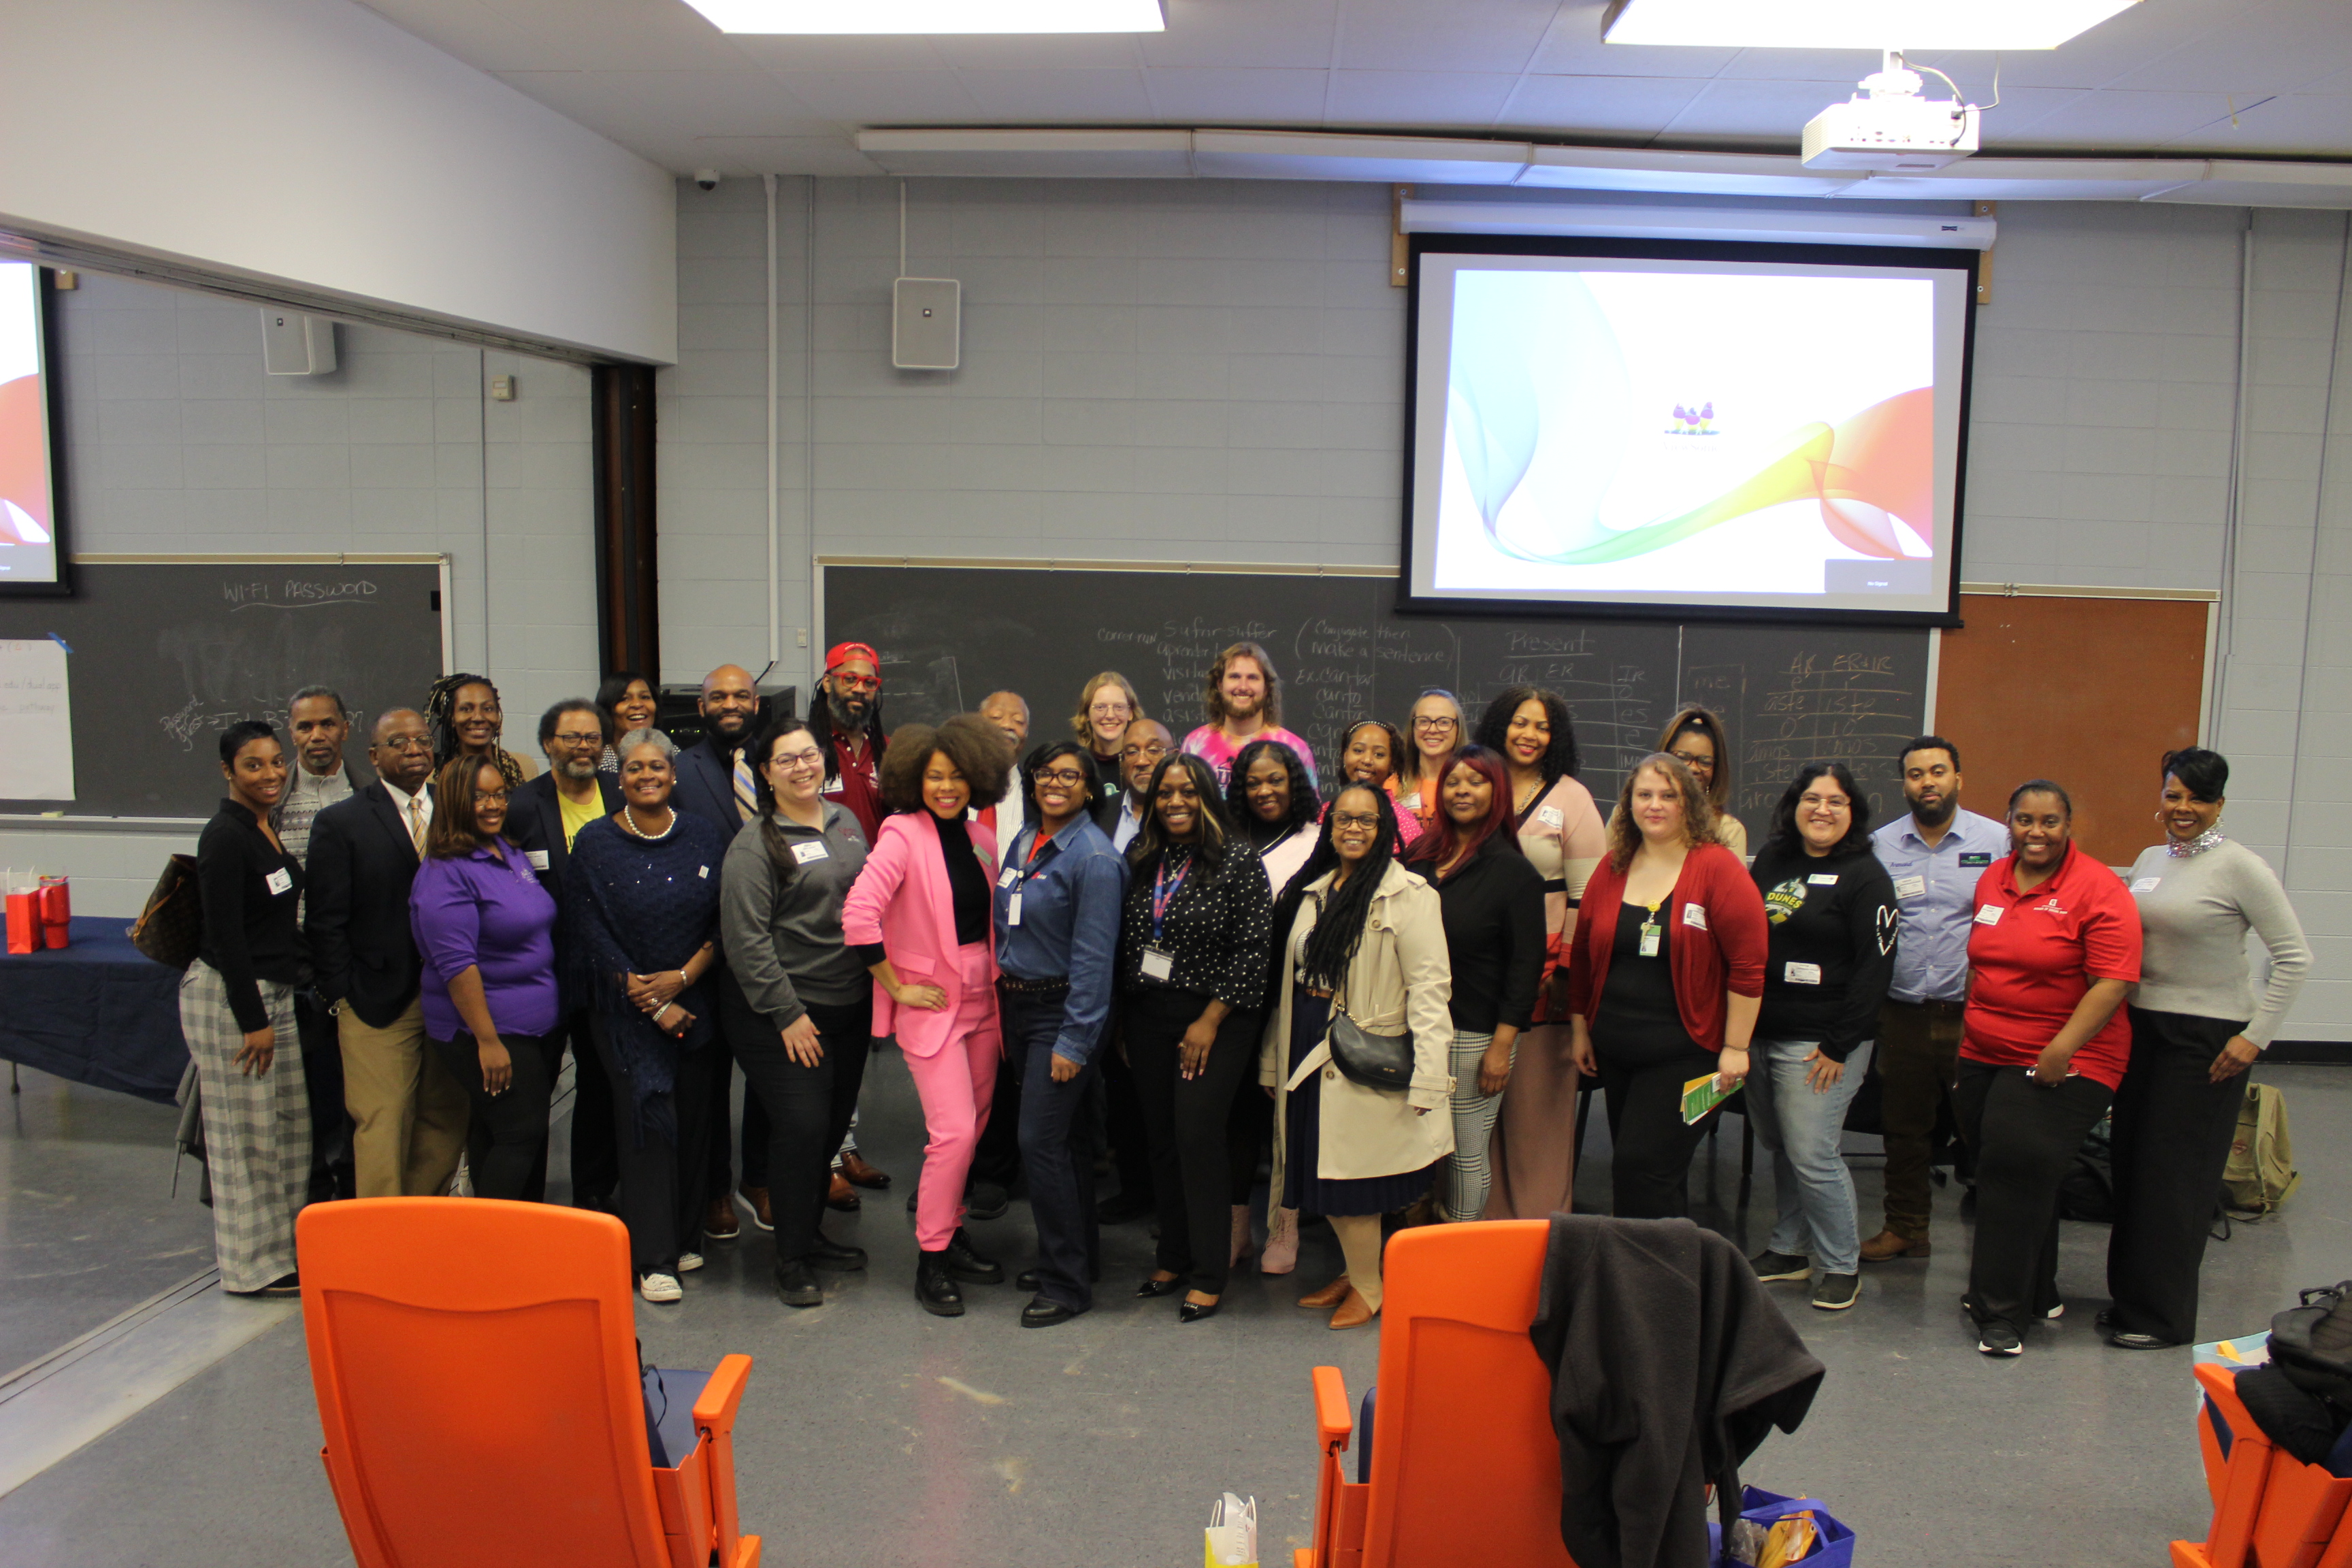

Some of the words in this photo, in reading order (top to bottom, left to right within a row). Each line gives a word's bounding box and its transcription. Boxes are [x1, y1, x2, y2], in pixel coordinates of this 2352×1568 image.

[223, 582, 269, 602] WI-FI
[285, 580, 378, 599] PASSWORD
[1505, 629, 1595, 652] Present
[1767, 892, 1804, 909] DUNES
